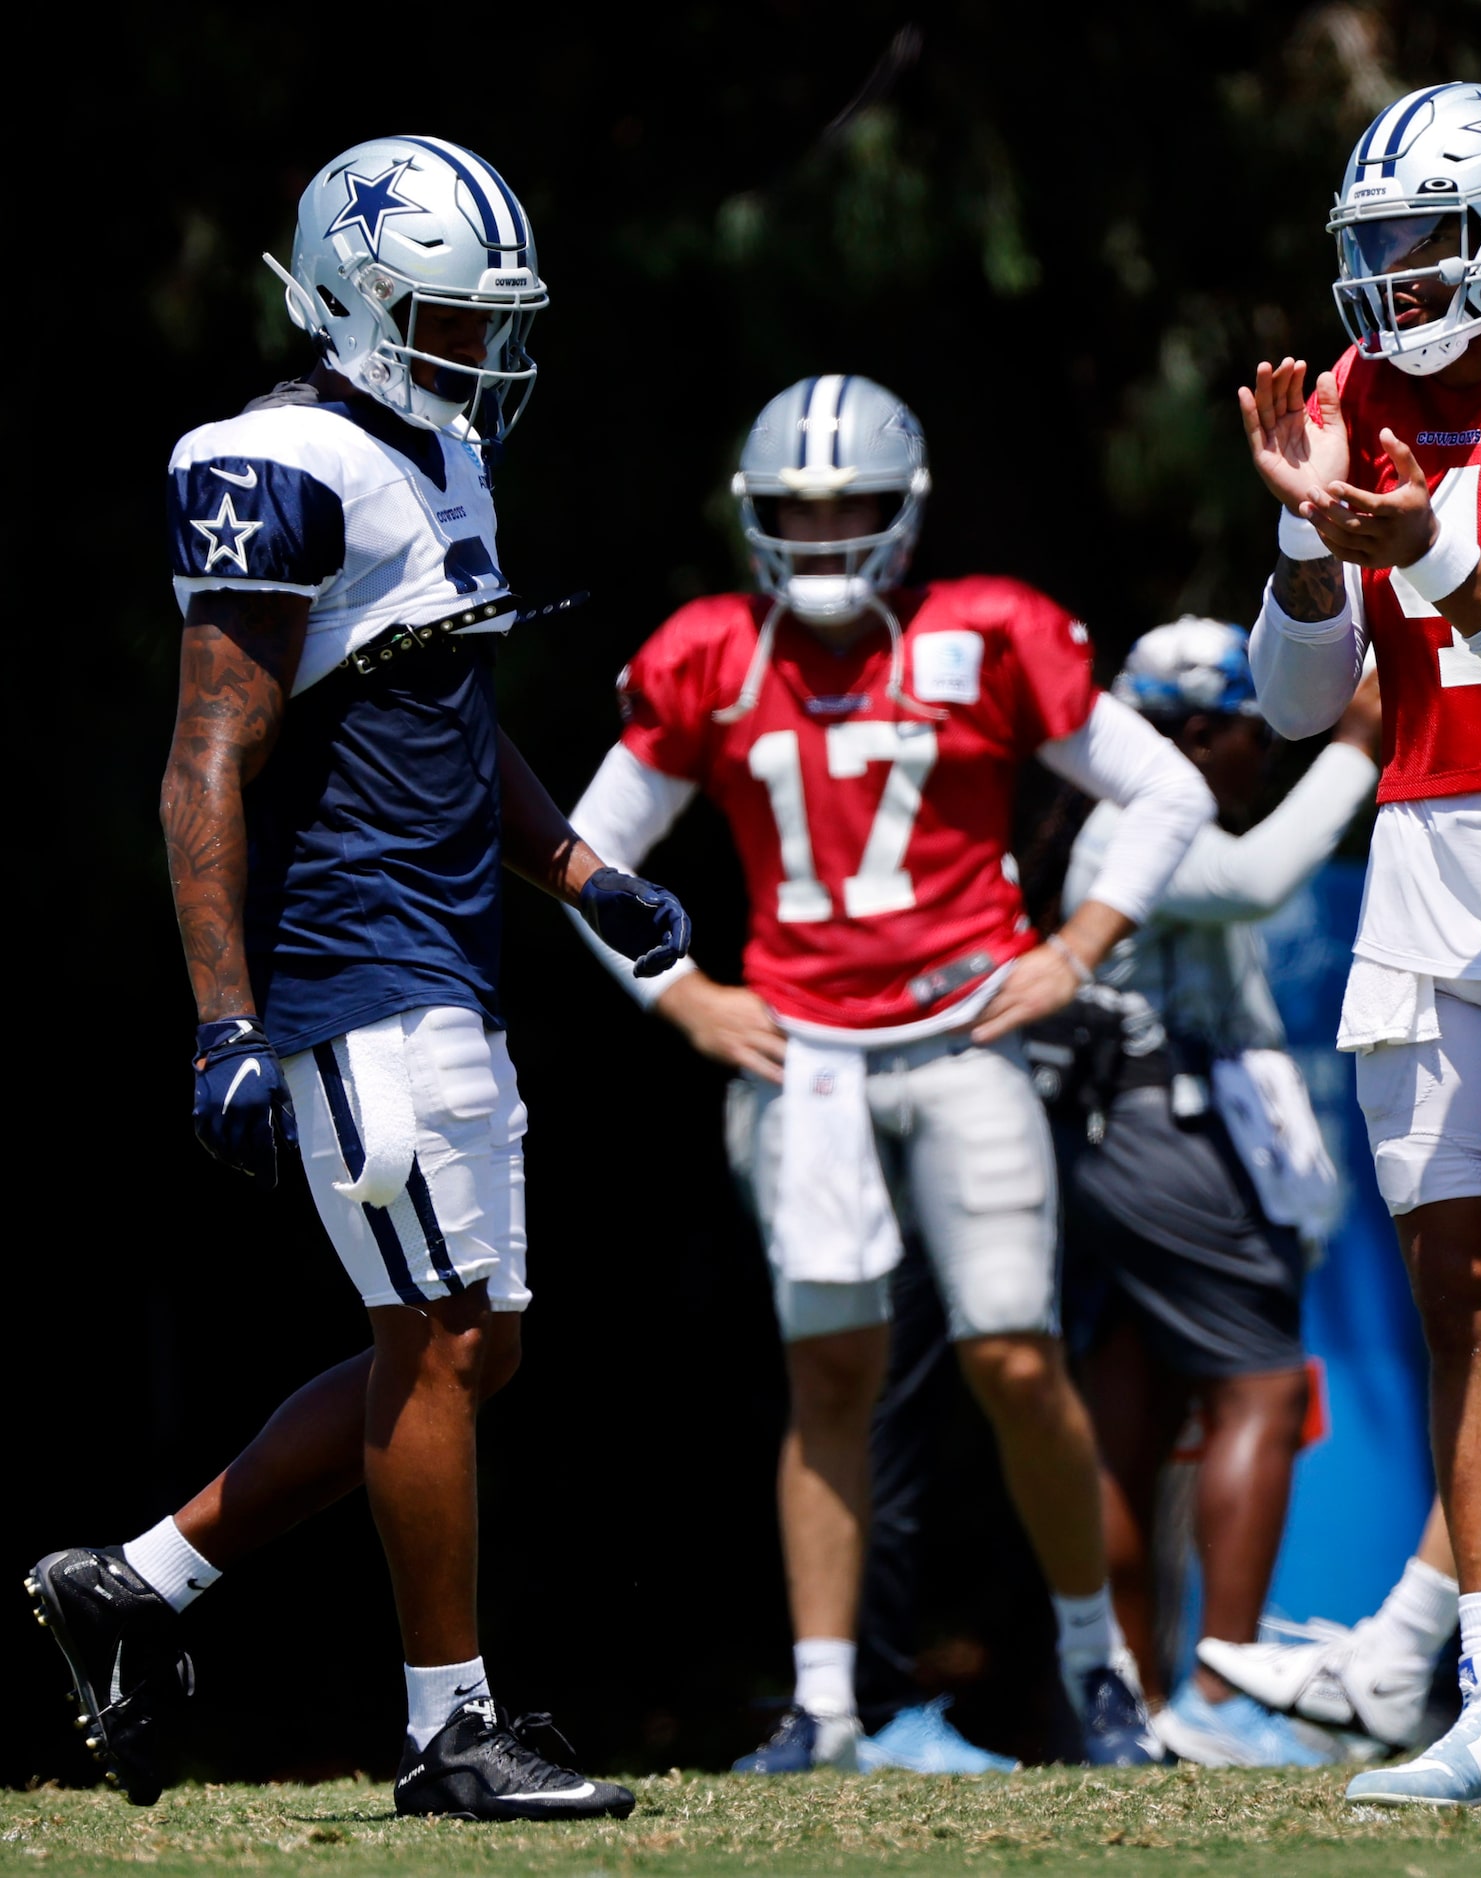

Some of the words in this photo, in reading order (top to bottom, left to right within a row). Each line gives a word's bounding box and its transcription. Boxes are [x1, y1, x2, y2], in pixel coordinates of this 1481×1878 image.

[1416, 429, 1481, 446] COWBOYS
[436, 505, 468, 524] COWBOYS
[748, 720, 939, 923] 17
[398, 1763, 425, 1789] ALPHA
